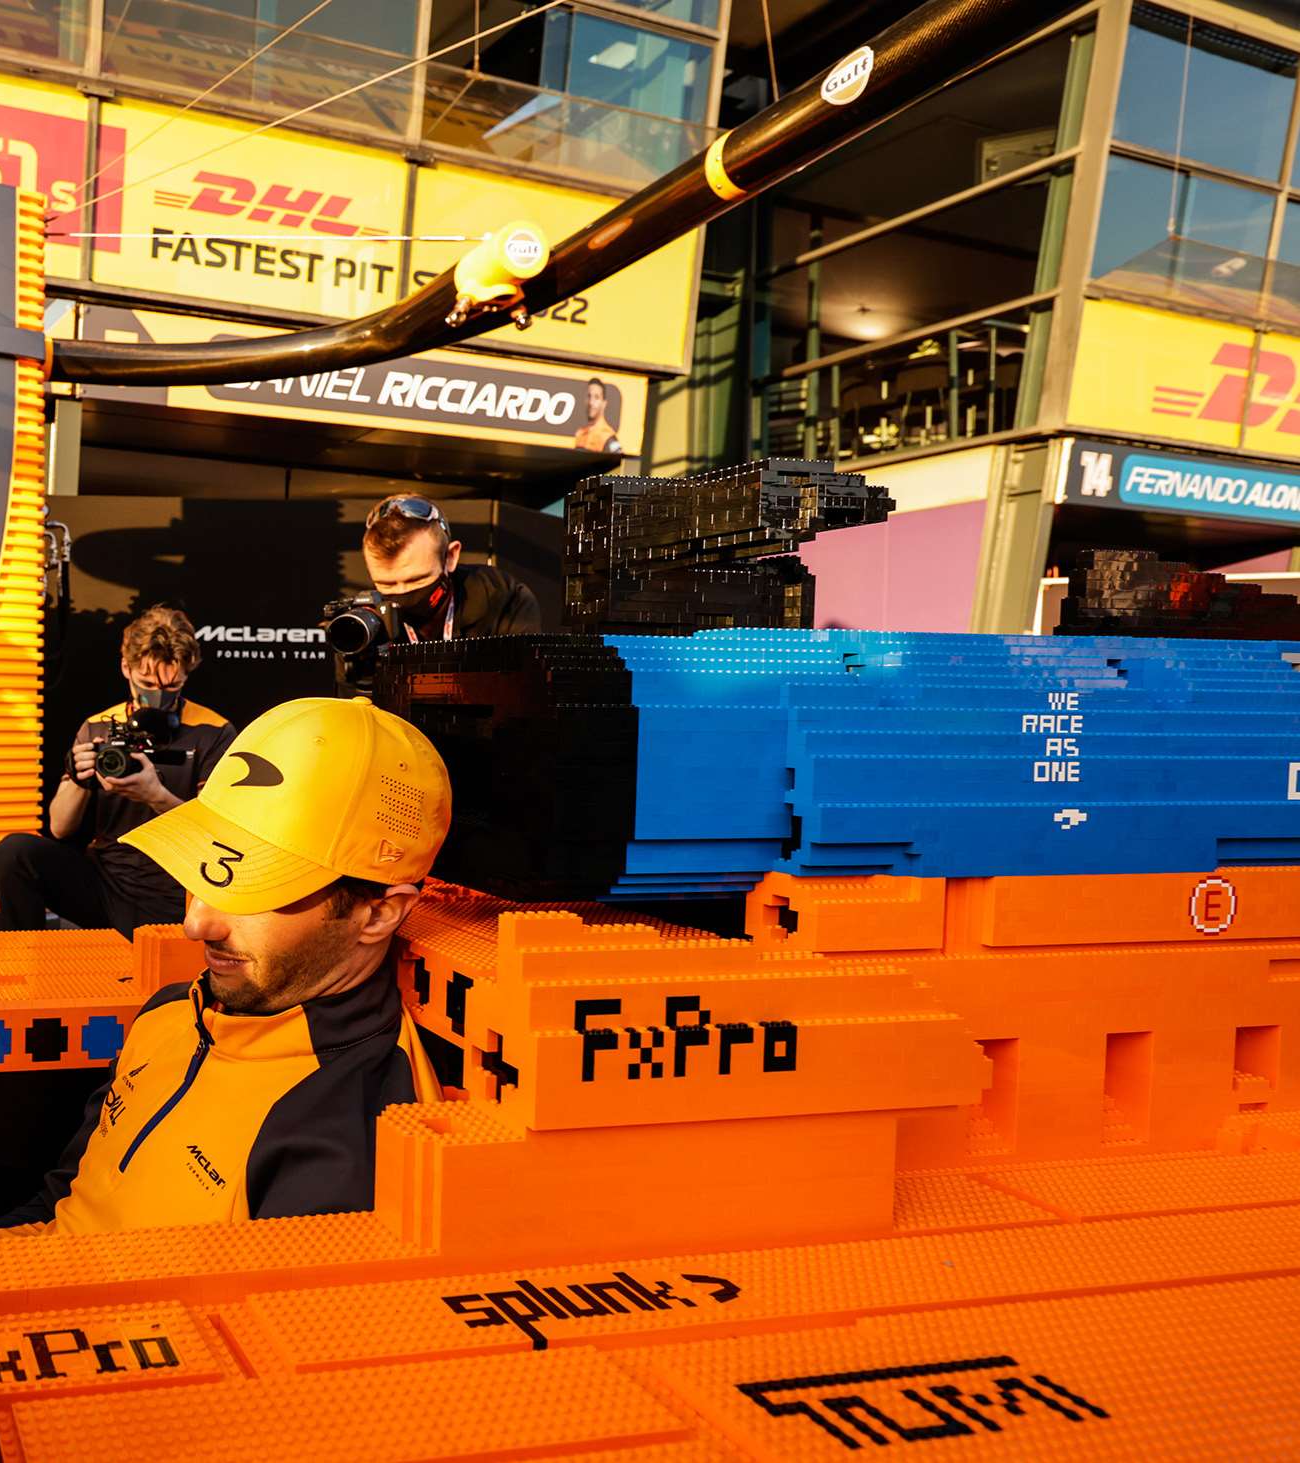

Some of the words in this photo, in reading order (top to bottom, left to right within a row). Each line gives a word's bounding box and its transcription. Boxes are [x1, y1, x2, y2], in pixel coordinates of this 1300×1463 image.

[825, 57, 869, 92] Gulf
[189, 170, 360, 237] DHL
[151, 227, 324, 283] FASTEST
[333, 256, 394, 294] PIT
[378, 370, 576, 426] RICCIARDO
[1079, 450, 1113, 497] 14
[1125, 465, 1248, 504] FERNANDO
[194, 625, 327, 643] McLaren
[216, 649, 275, 660] FORMULA
[294, 650, 326, 660] TEAM
[1047, 692, 1079, 711] WE
[1021, 714, 1084, 734] RACE
[1045, 737, 1080, 757] AS
[1033, 761, 1081, 782] ONE
[200, 840, 245, 888] 3
[574, 995, 798, 1082] FxPro
[735, 1355, 1111, 1450] TUMI
